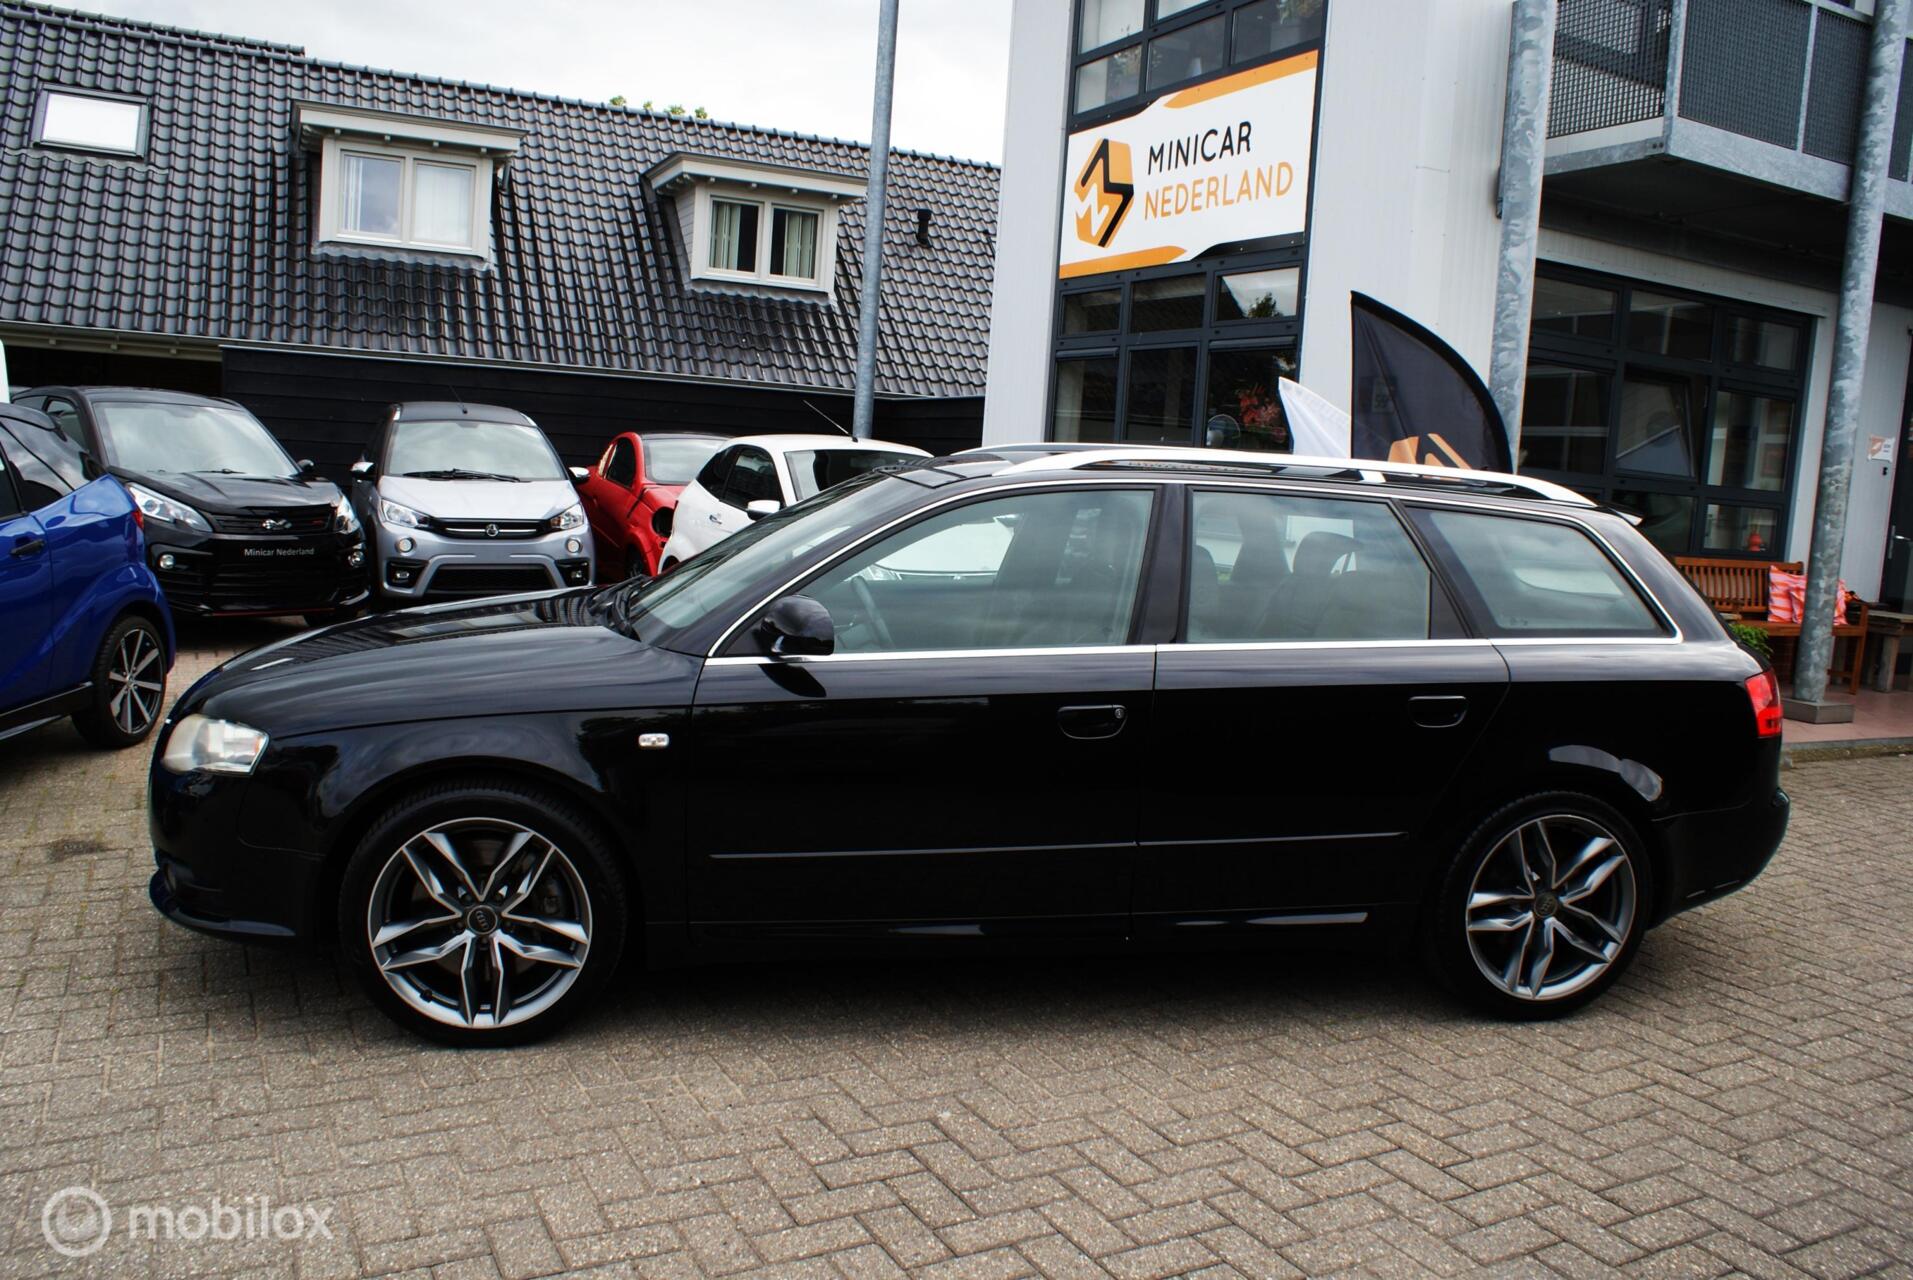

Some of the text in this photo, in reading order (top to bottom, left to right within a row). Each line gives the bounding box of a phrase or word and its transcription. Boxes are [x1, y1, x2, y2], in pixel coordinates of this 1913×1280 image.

[1148, 121, 1251, 175] MINICAR
[1145, 161, 1294, 220] NEDERLAND
[244, 547, 315, 557] Minicar Nederland
